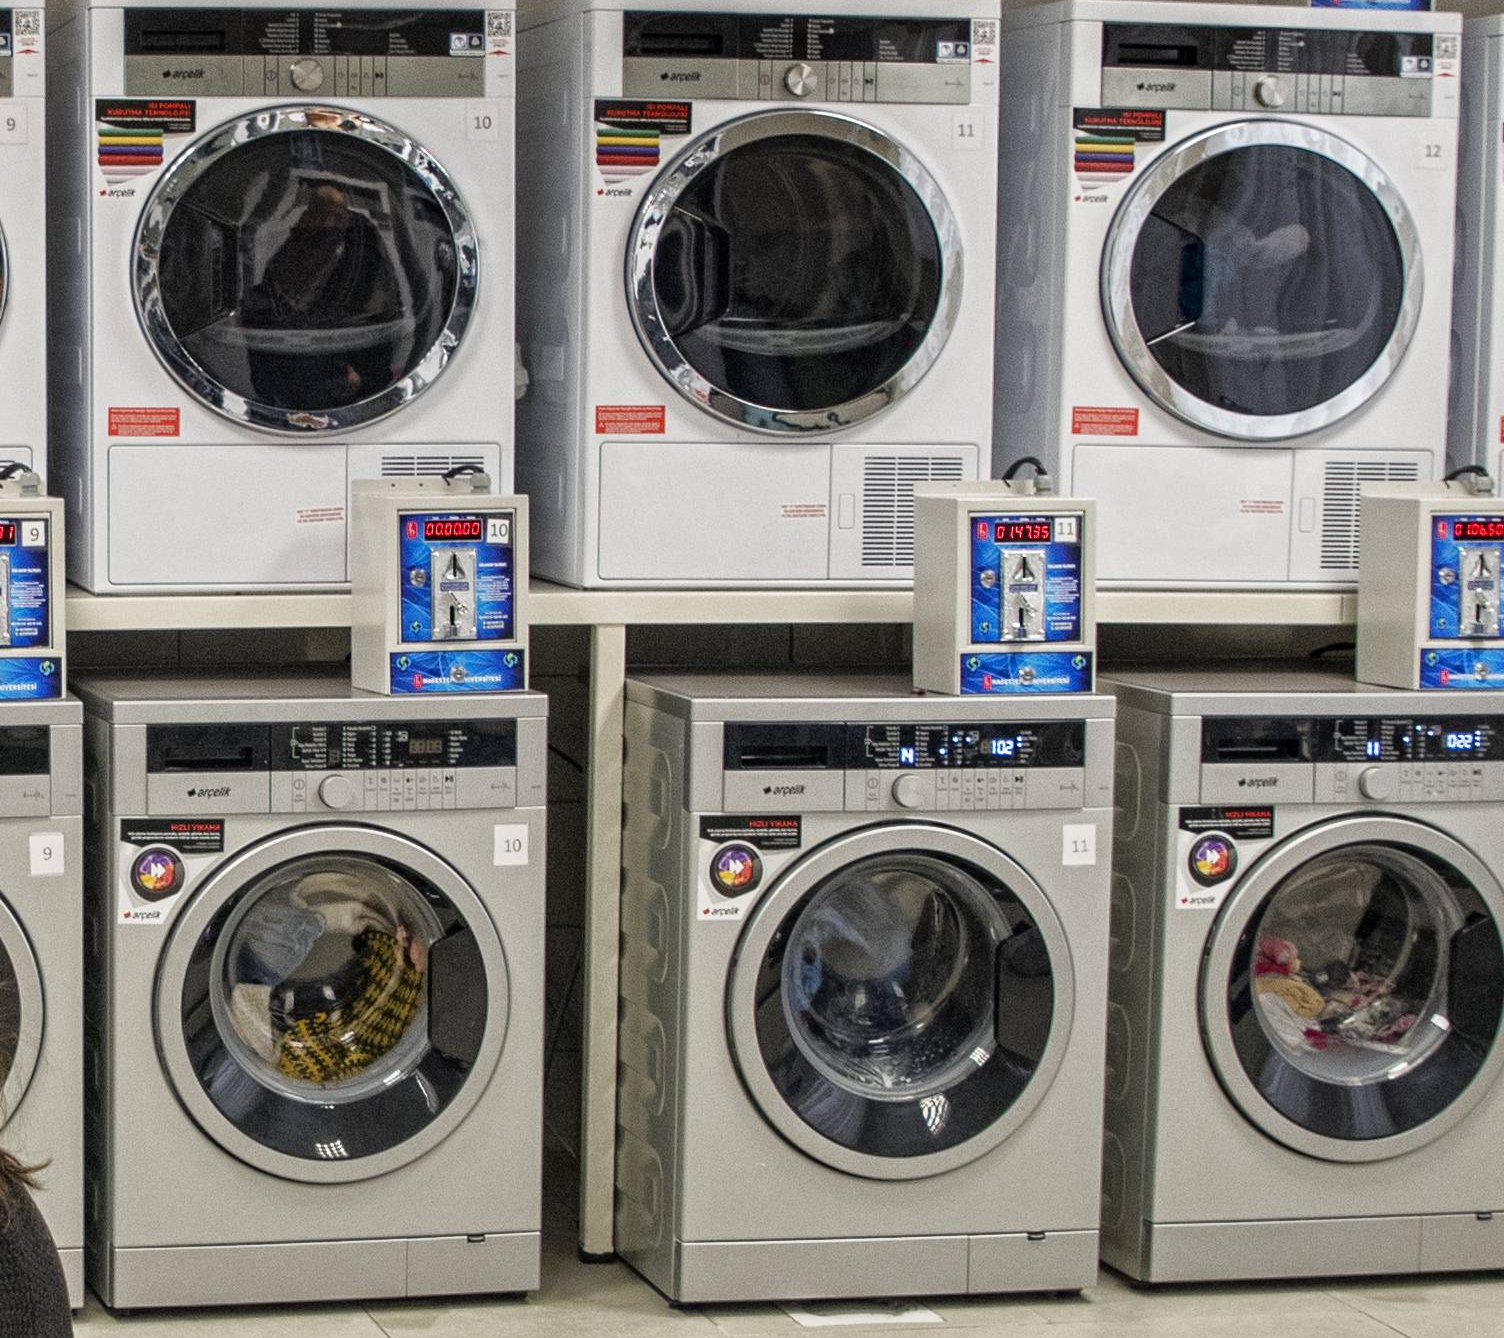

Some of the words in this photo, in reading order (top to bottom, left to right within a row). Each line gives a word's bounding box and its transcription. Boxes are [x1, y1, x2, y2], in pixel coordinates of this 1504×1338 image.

[172, 68, 205, 80] arçelik
[5, 117, 15, 132] 9
[473, 116, 492, 130] 10
[957, 123, 975, 137] 11
[1424, 144, 1442, 157] 12
[30, 527, 40, 541] 9
[490, 523, 508, 537] 10
[1057, 522, 1074, 536] 11
[197, 786, 231, 800] arçelik
[772, 784, 806, 797] arçelik
[503, 838, 523, 853] 10
[1071, 839, 1089, 854] 11
[42, 847, 53, 862] 9
[132, 910, 161, 921] arçelik
